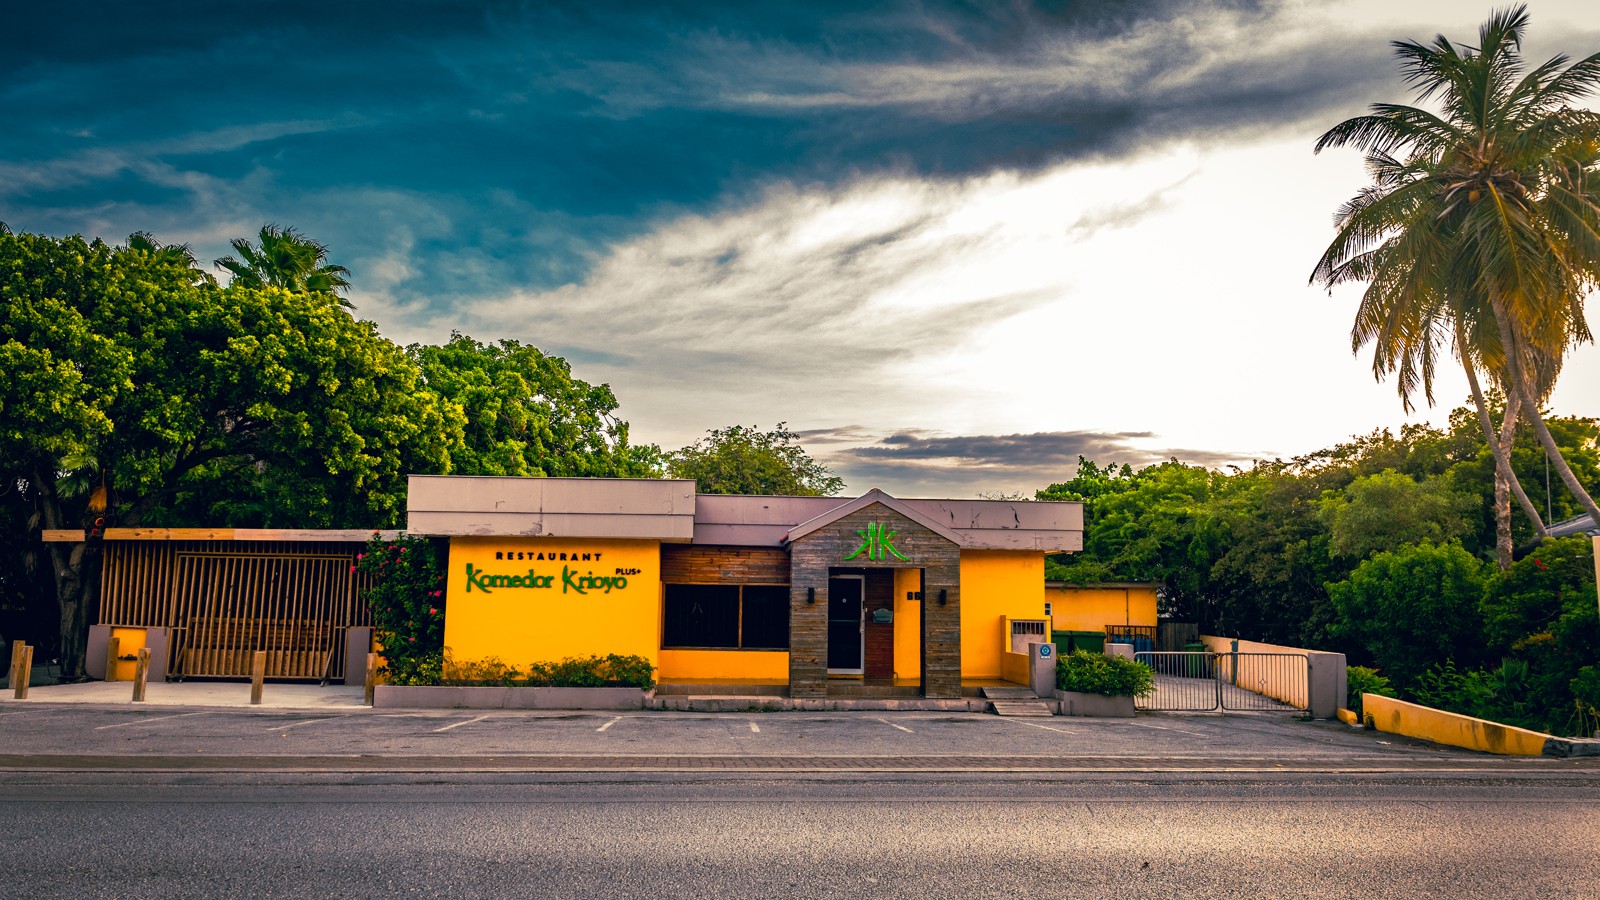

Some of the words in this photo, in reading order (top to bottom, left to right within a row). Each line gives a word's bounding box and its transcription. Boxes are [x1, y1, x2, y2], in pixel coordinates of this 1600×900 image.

[495, 552, 602, 561] RESTAURANT
[466, 563, 555, 594] Komedor
[562, 565, 627, 595] Krioyo
